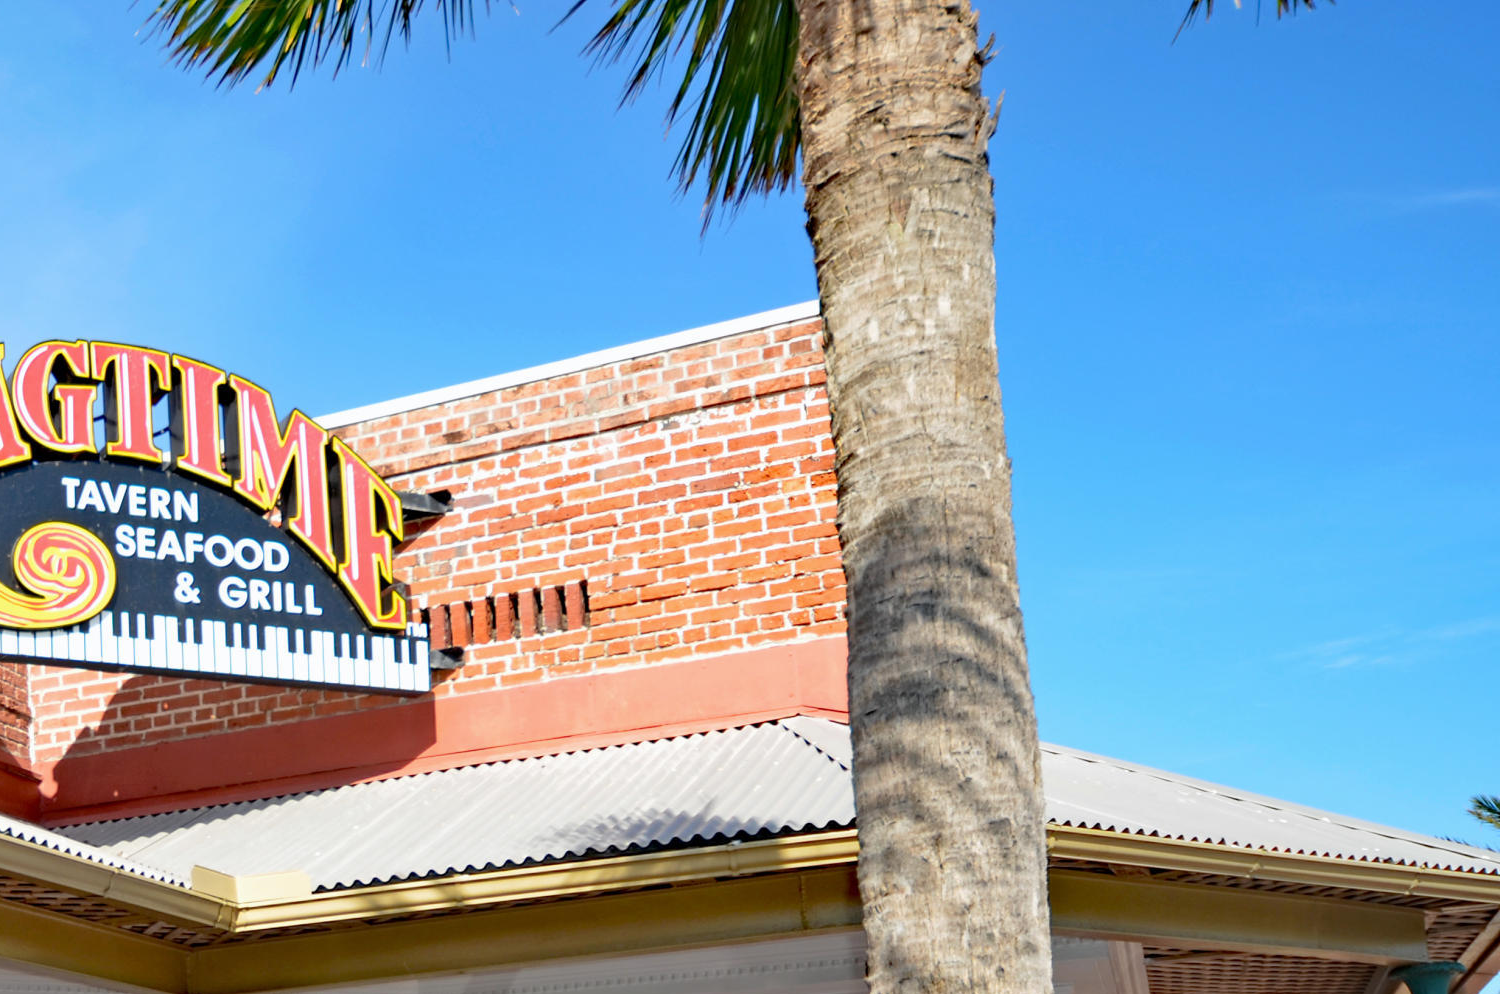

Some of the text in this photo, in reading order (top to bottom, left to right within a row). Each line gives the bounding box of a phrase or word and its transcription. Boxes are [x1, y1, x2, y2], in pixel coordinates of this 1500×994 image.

[61, 476, 199, 523] TAVERN
[114, 523, 290, 573] SEAFOOD
[173, 570, 324, 616] & GRILL
